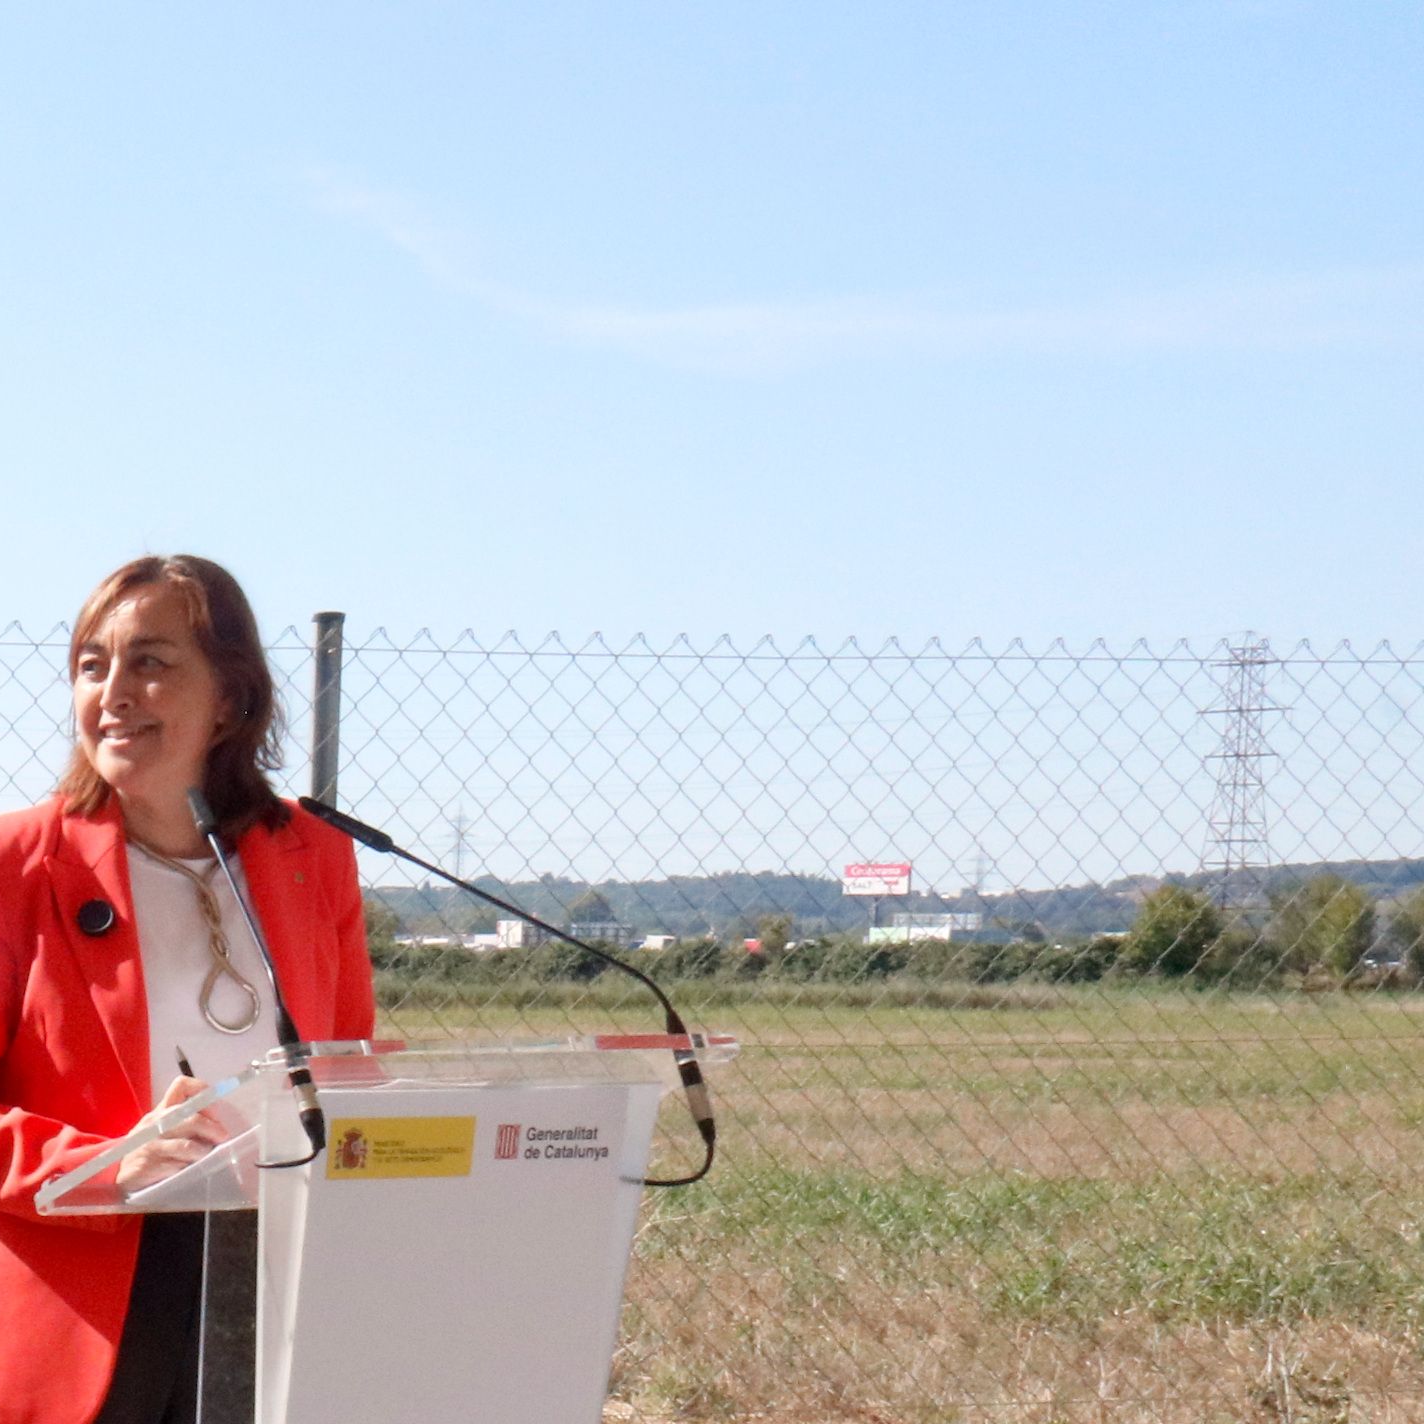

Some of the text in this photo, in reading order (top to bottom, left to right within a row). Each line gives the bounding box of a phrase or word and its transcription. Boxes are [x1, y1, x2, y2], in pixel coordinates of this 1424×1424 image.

[525, 1126, 599, 1141] Generalitat
[523, 1143, 609, 1162] de Catalunya
